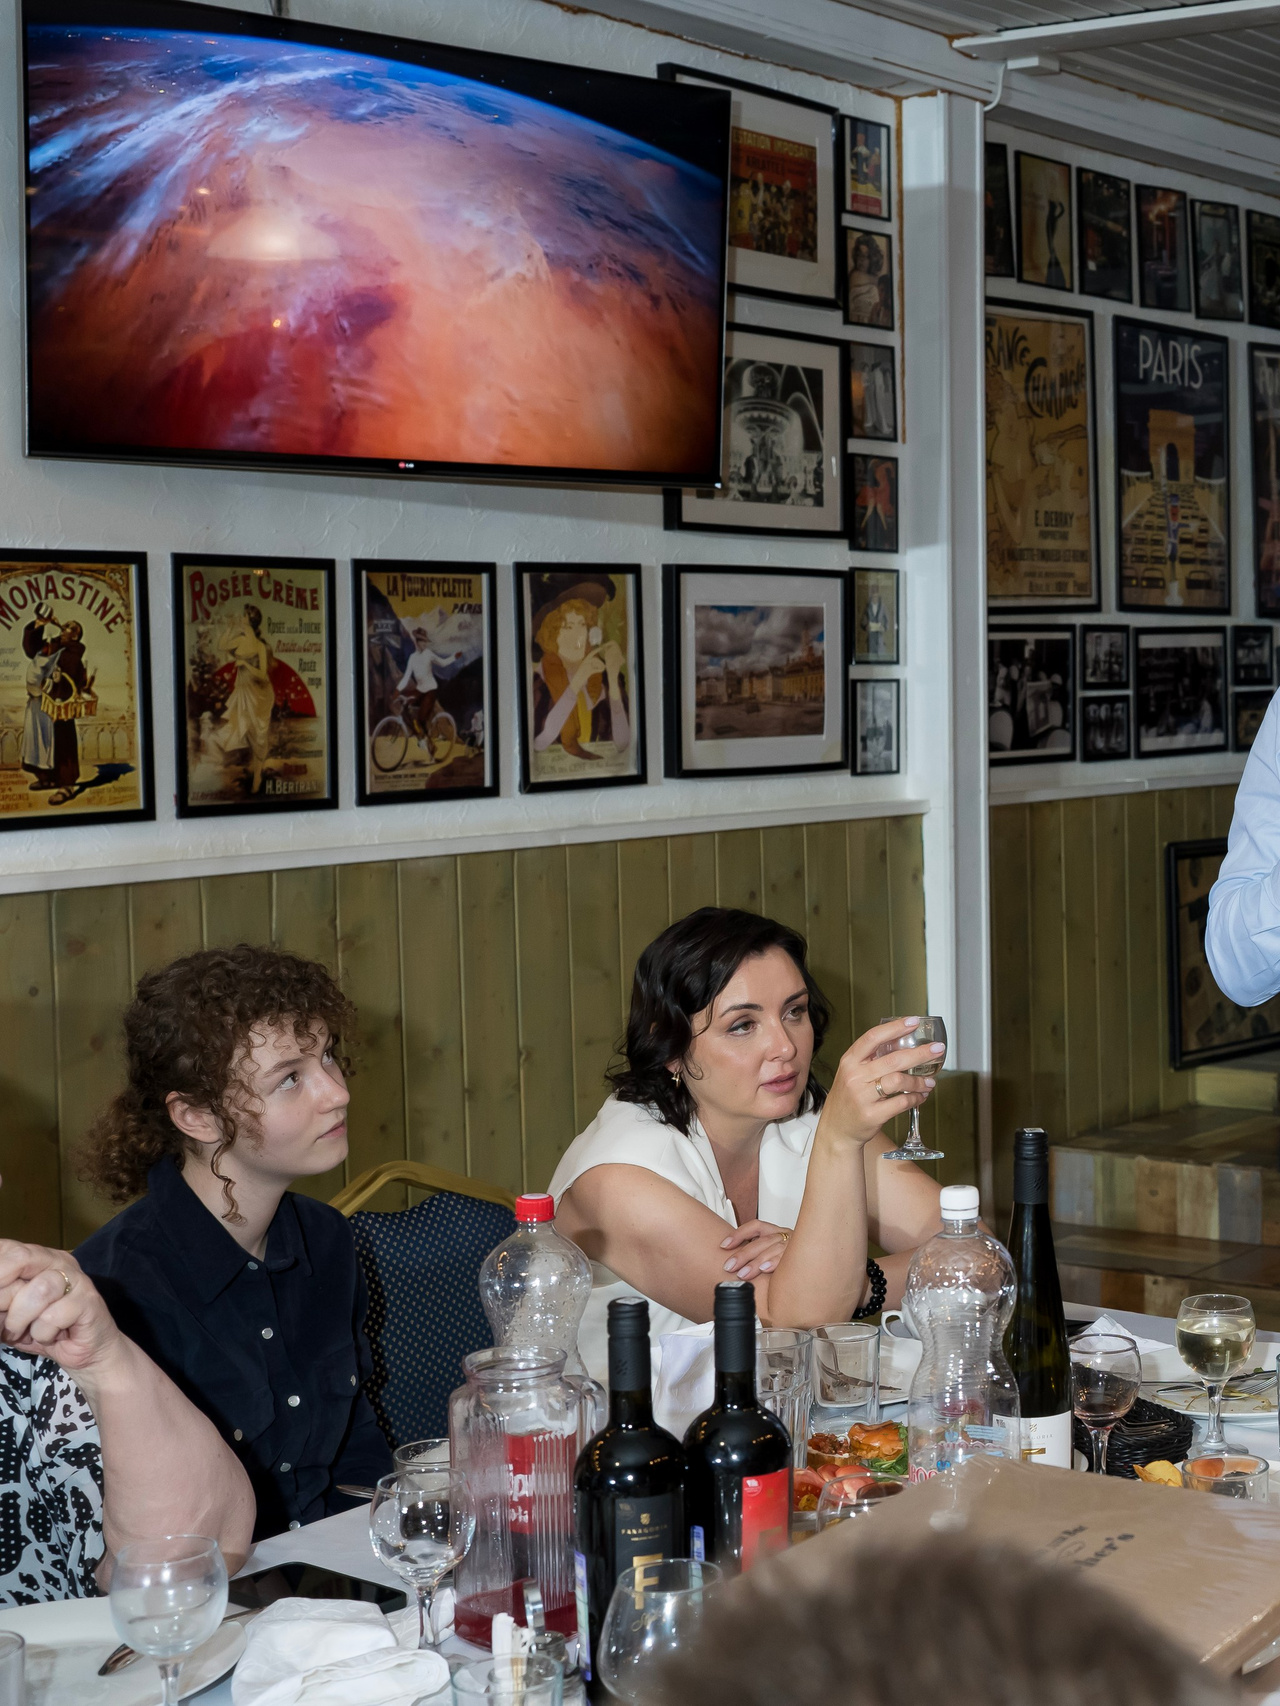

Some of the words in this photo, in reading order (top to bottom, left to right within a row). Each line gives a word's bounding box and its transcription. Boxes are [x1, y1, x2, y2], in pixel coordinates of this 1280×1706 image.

[1138, 334, 1204, 389] PARIS
[0, 575, 126, 634] MONASTINE
[386, 574, 399, 597] LA
[452, 603, 482, 615] PARIS
